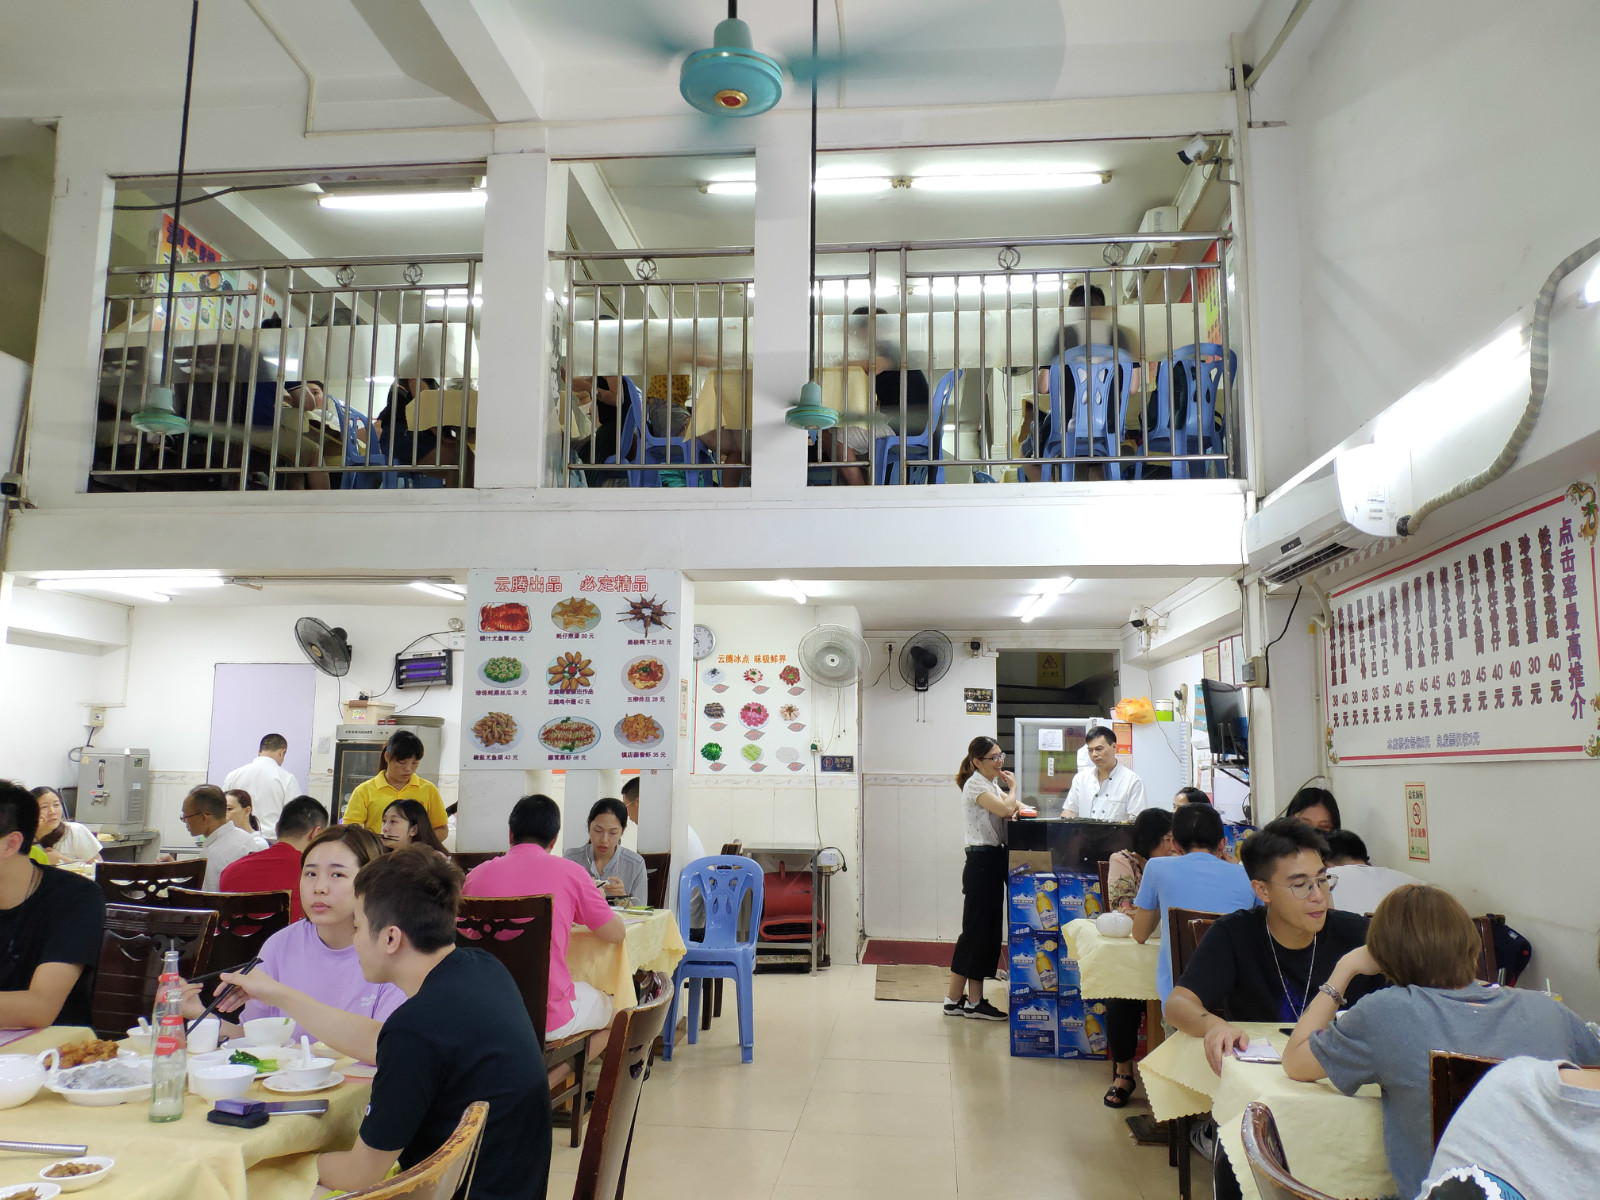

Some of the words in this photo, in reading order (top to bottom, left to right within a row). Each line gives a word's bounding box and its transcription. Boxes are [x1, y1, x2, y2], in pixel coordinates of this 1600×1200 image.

[494, 575, 562, 593] 云腾出品
[580, 575, 649, 592] 必定精品
[1559, 517, 1586, 720] 点击率最高推介
[1509, 660, 1521, 678] 40
[1528, 656, 1540, 675] 30
[1548, 653, 1561, 671] 40
[1446, 672, 1456, 688] 43
[1461, 669, 1471, 686] 28
[1476, 666, 1486, 683] 45
[1492, 664, 1503, 681] 40
[1394, 682, 1402, 696] 40
[1406, 680, 1414, 695] 45
[1420, 678, 1428, 692] 45
[1432, 675, 1440, 690] 45
[1362, 689, 1368, 702] 58
[1372, 687, 1379, 701] 35
[1382, 685, 1390, 699] 35
[1494, 688, 1505, 709] 元
[1512, 686, 1523, 707] 元
[1531, 683, 1542, 705] 元
[1551, 680, 1563, 703] 元
[1421, 700, 1428, 718] 元
[1434, 698, 1442, 716] 元
[1448, 695, 1457, 715] 元
[1462, 693, 1472, 713] 元
[1478, 691, 1488, 711] 元
[1343, 711, 1349, 727] 元
[1353, 710, 1358, 726] 元
[1363, 708, 1369, 725] 元
[1373, 707, 1379, 723] 元
[1384, 705, 1391, 722] 元
[1396, 703, 1403, 721] 元
[1408, 702, 1415, 719] 元
[1334, 713, 1339, 728] 元
